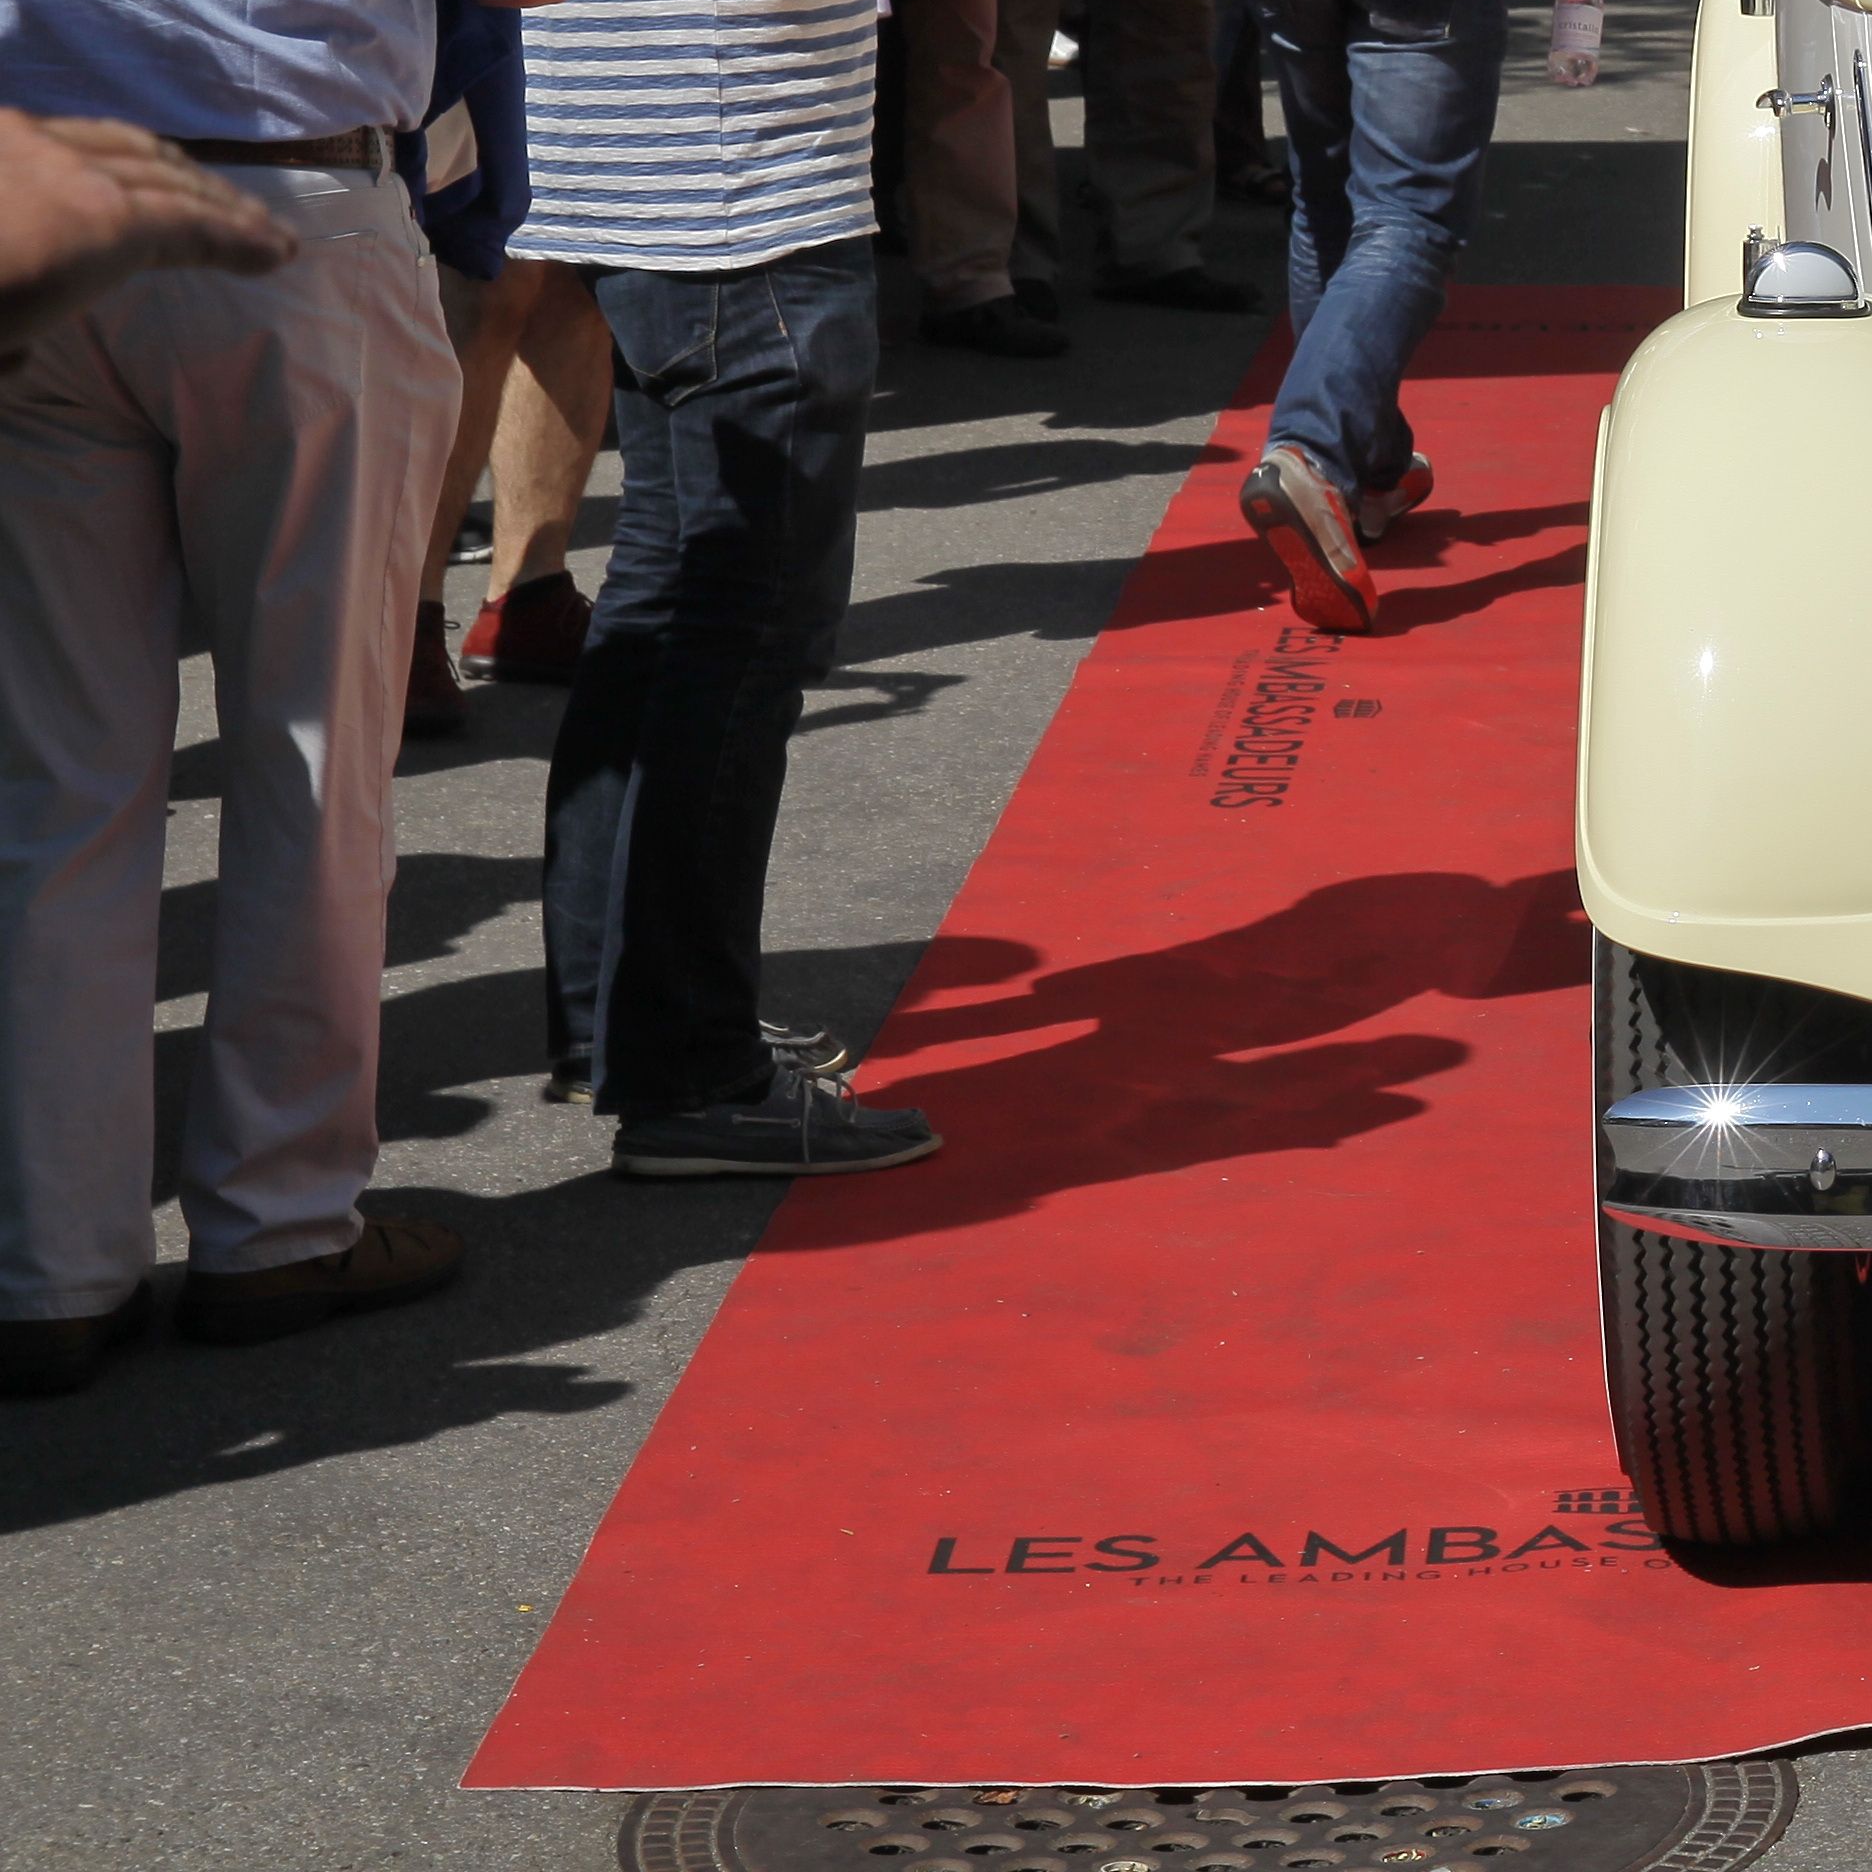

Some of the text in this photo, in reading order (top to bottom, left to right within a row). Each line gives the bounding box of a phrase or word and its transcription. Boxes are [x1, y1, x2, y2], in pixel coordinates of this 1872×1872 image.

[1209, 656, 1336, 809] MBASSADEURS
[926, 1534, 1161, 1575] LES
[1131, 1556, 1672, 1587] THE LEADING HOUSE O
